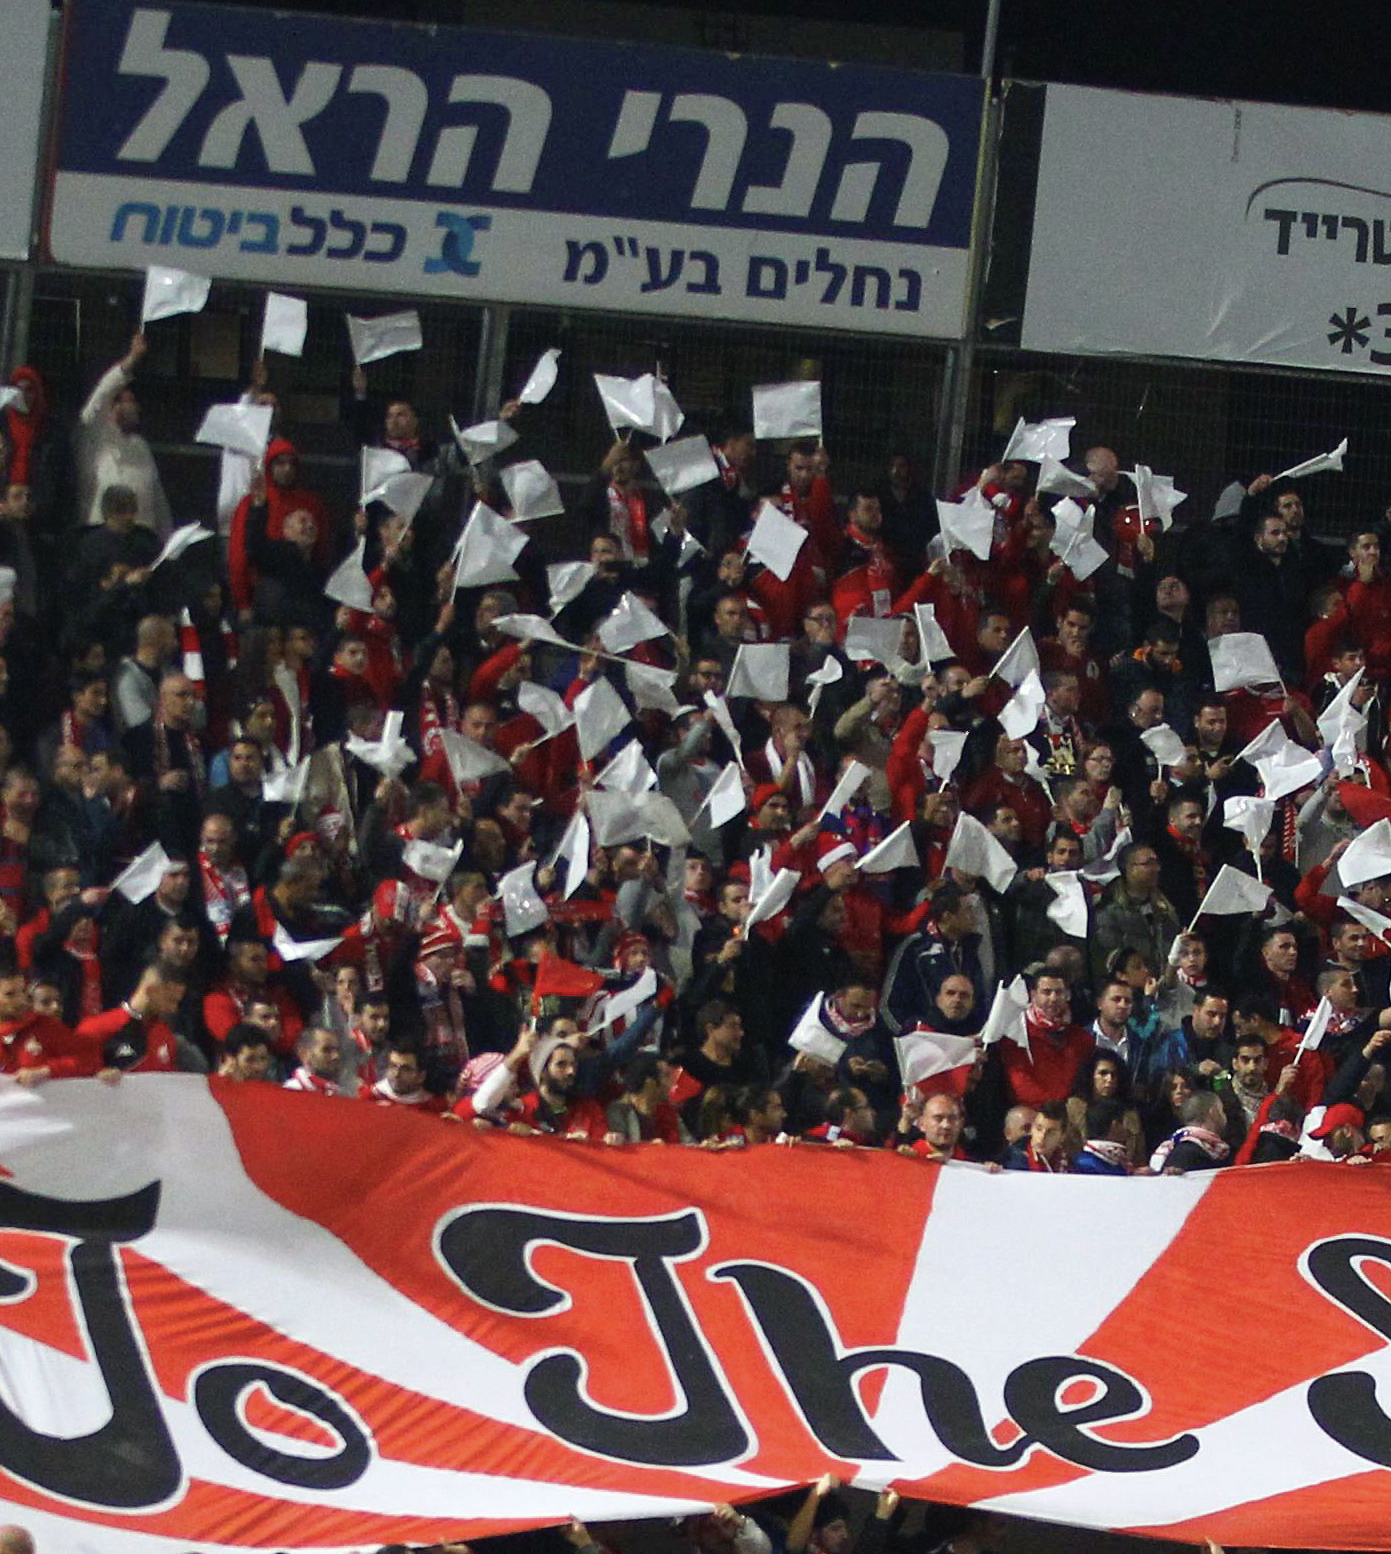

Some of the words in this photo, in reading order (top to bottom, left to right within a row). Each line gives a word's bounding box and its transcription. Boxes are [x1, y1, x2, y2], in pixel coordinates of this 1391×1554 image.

[115, 10, 554, 193] הראל
[608, 90, 950, 229] הנרי
[745, 247, 923, 312] נחלים
[440, 1206, 1200, 1473] The
